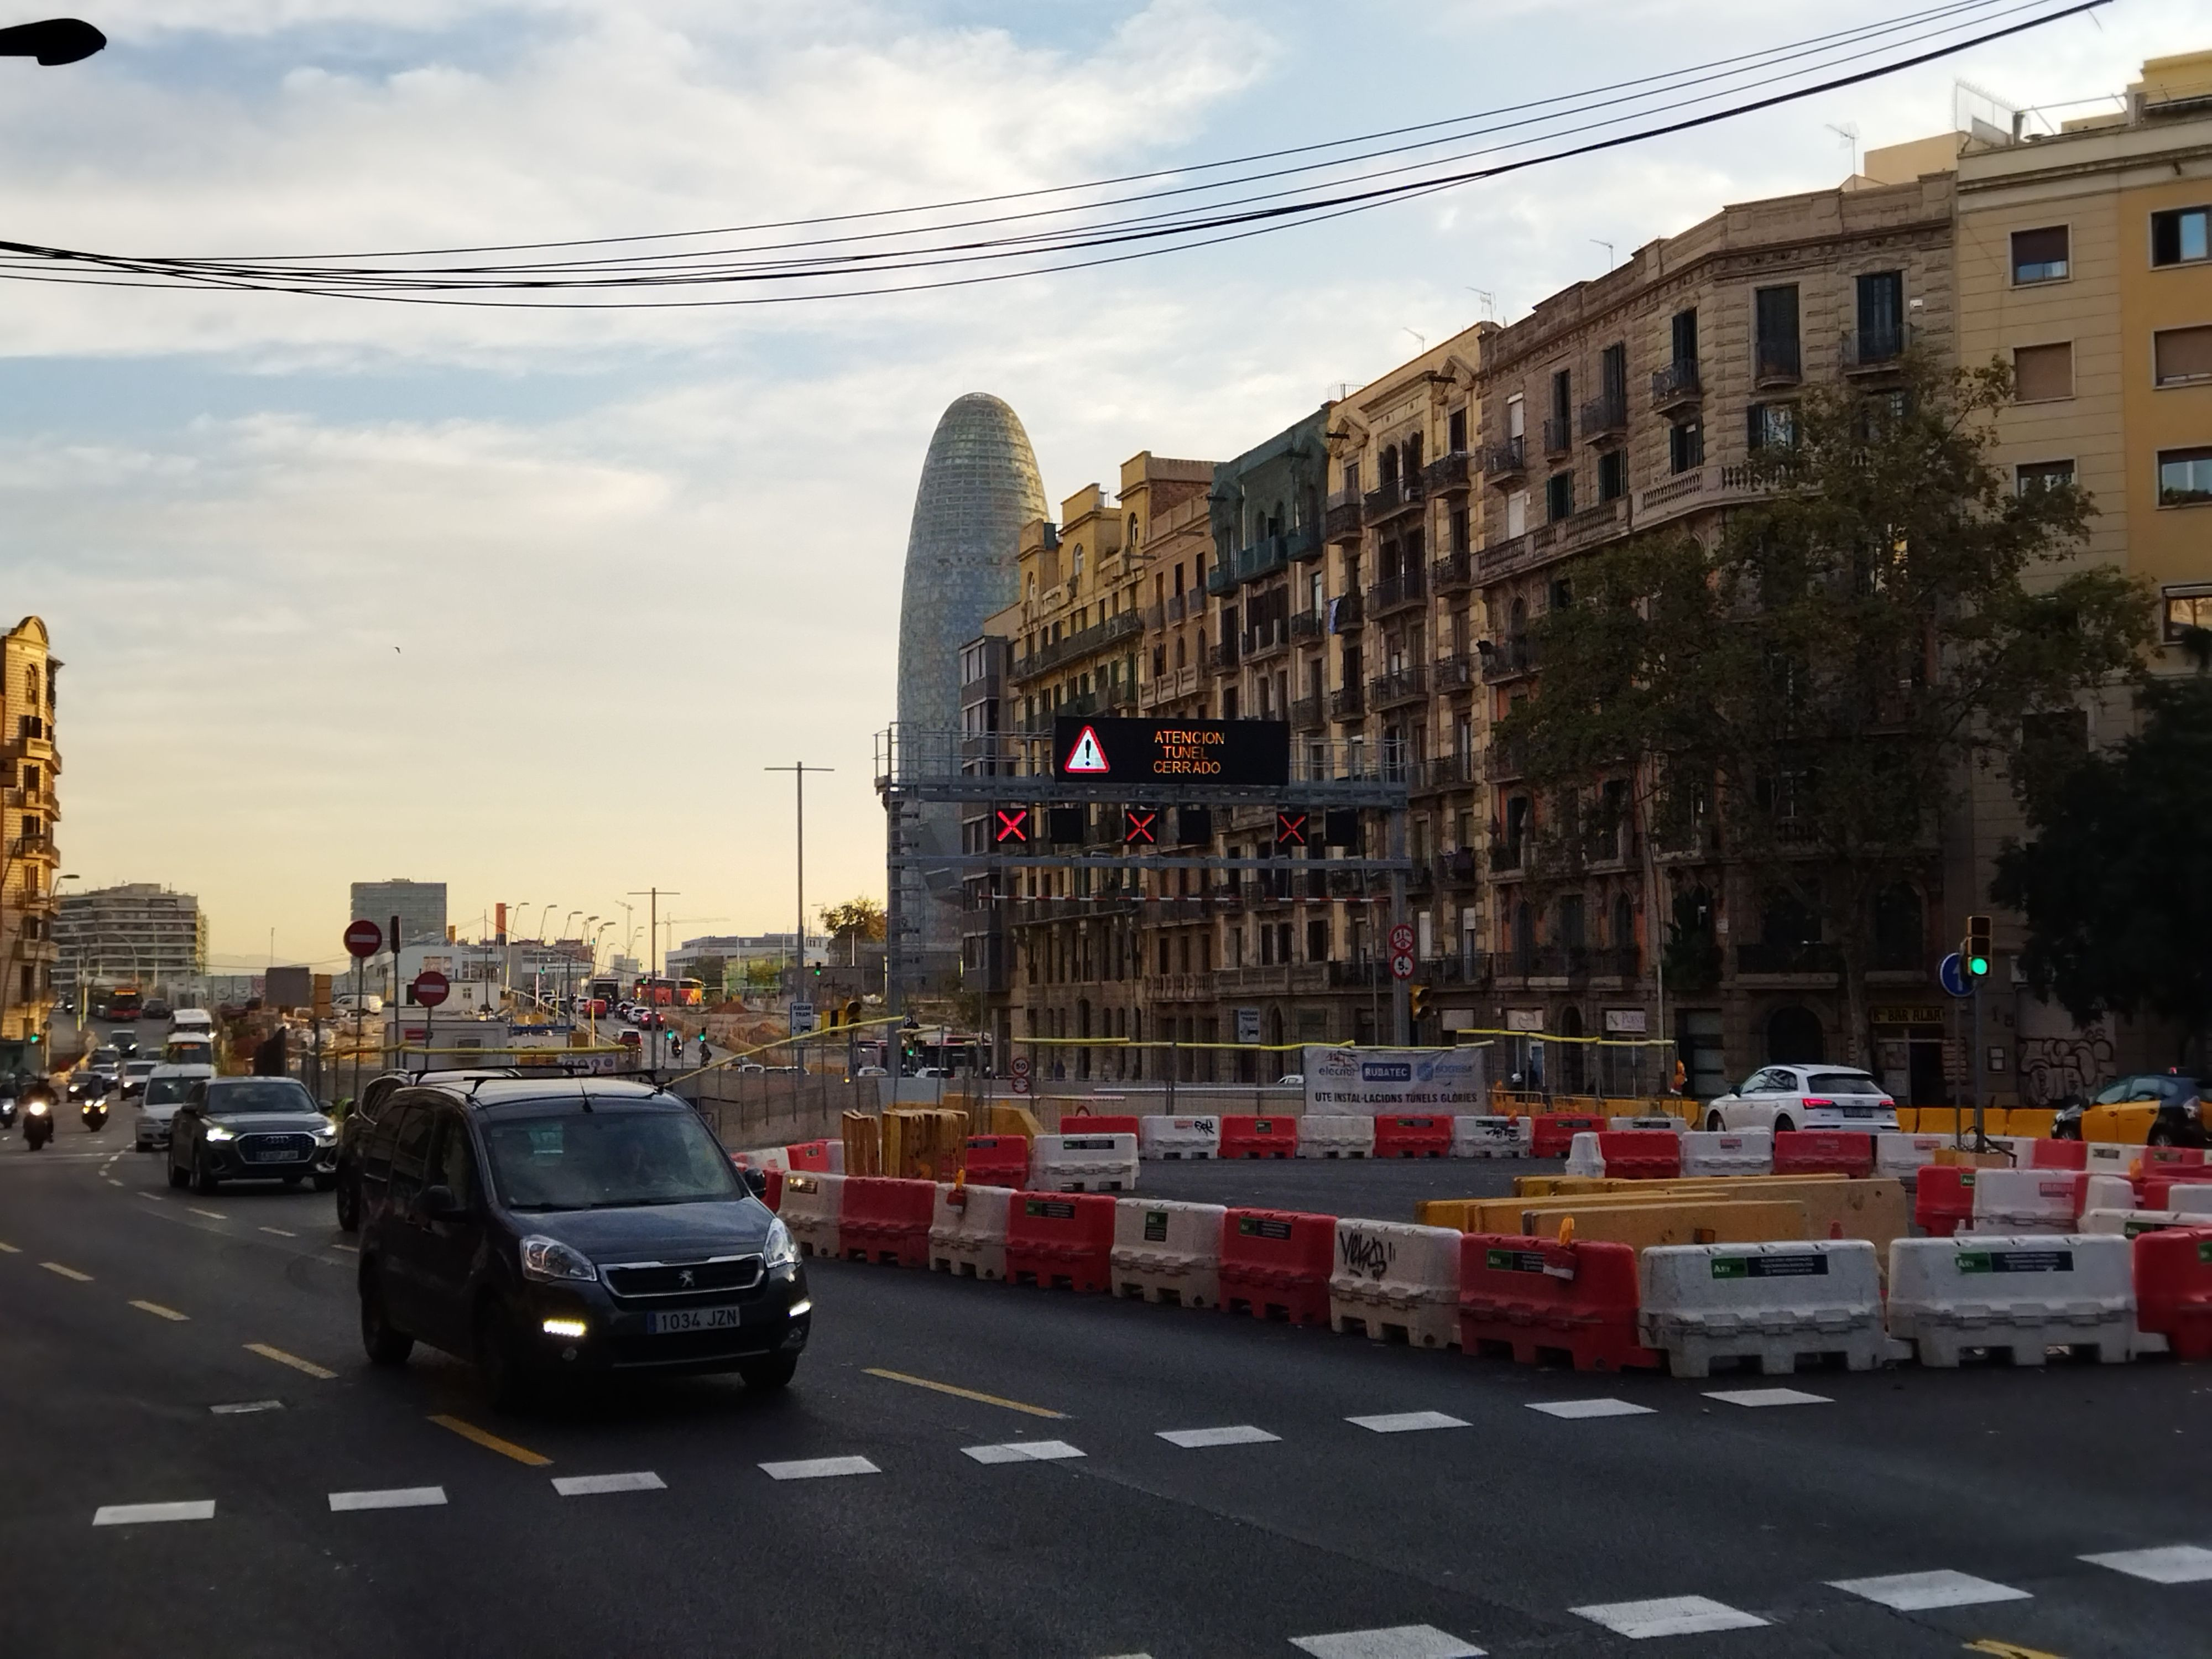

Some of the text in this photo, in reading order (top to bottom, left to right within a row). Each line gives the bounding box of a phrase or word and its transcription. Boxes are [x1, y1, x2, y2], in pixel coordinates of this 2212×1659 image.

[1154, 731, 1225, 744] ATENCION
[1162, 745, 1208, 759] TUNEL
[1154, 761, 1221, 774] CERRADO
[1888, 1009, 1908, 1022] BAR
[1365, 1067, 1408, 1077] RUBATEC
[1315, 1092, 1332, 1102] UTE
[661, 1309, 737, 1331] 1034 JZN
